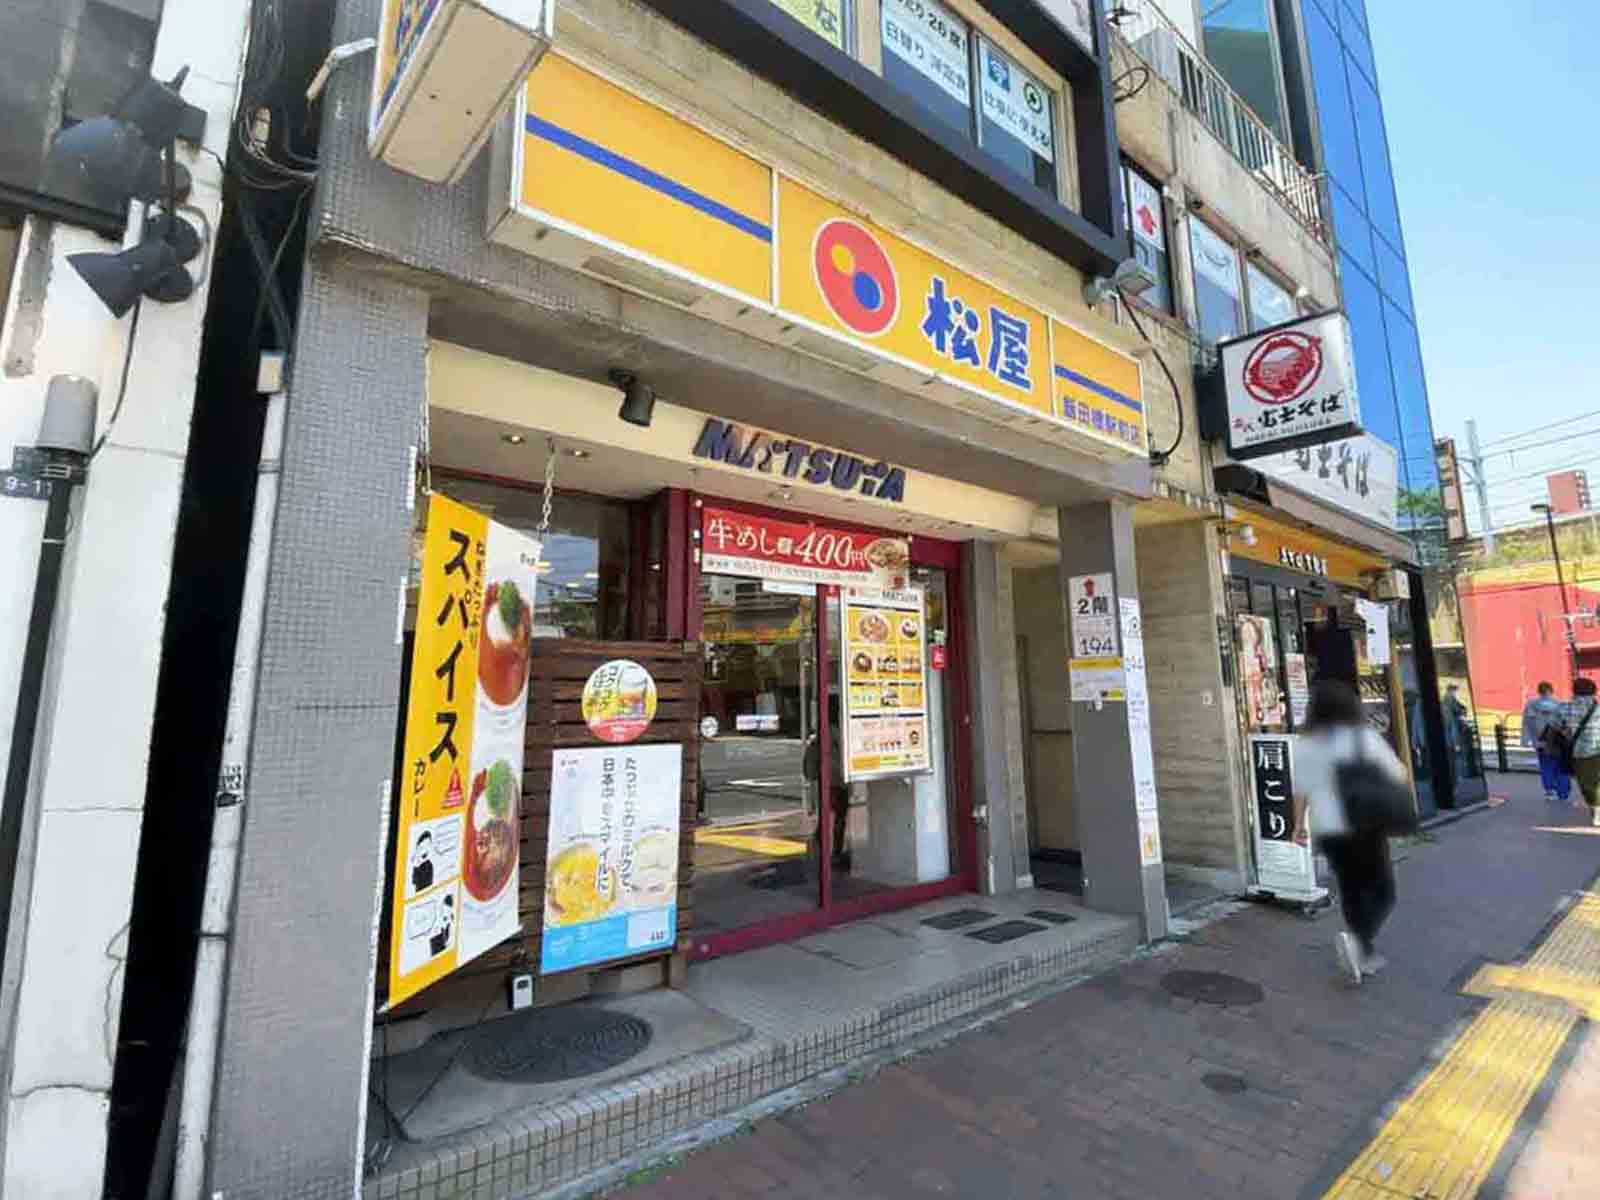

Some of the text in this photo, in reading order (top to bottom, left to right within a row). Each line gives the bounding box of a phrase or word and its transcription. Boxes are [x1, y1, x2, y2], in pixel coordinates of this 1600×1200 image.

[921, 277, 1033, 391] 松屋
[1257, 391, 1345, 429] 富士そば
[692, 417, 907, 502] MATSUYA
[1077, 595, 1110, 615] 2階
[428, 528, 474, 766] スパイス
[1080, 636, 1113, 656] 194
[412, 758, 427, 818] カレー
[1257, 742, 1287, 839] 肩こり
